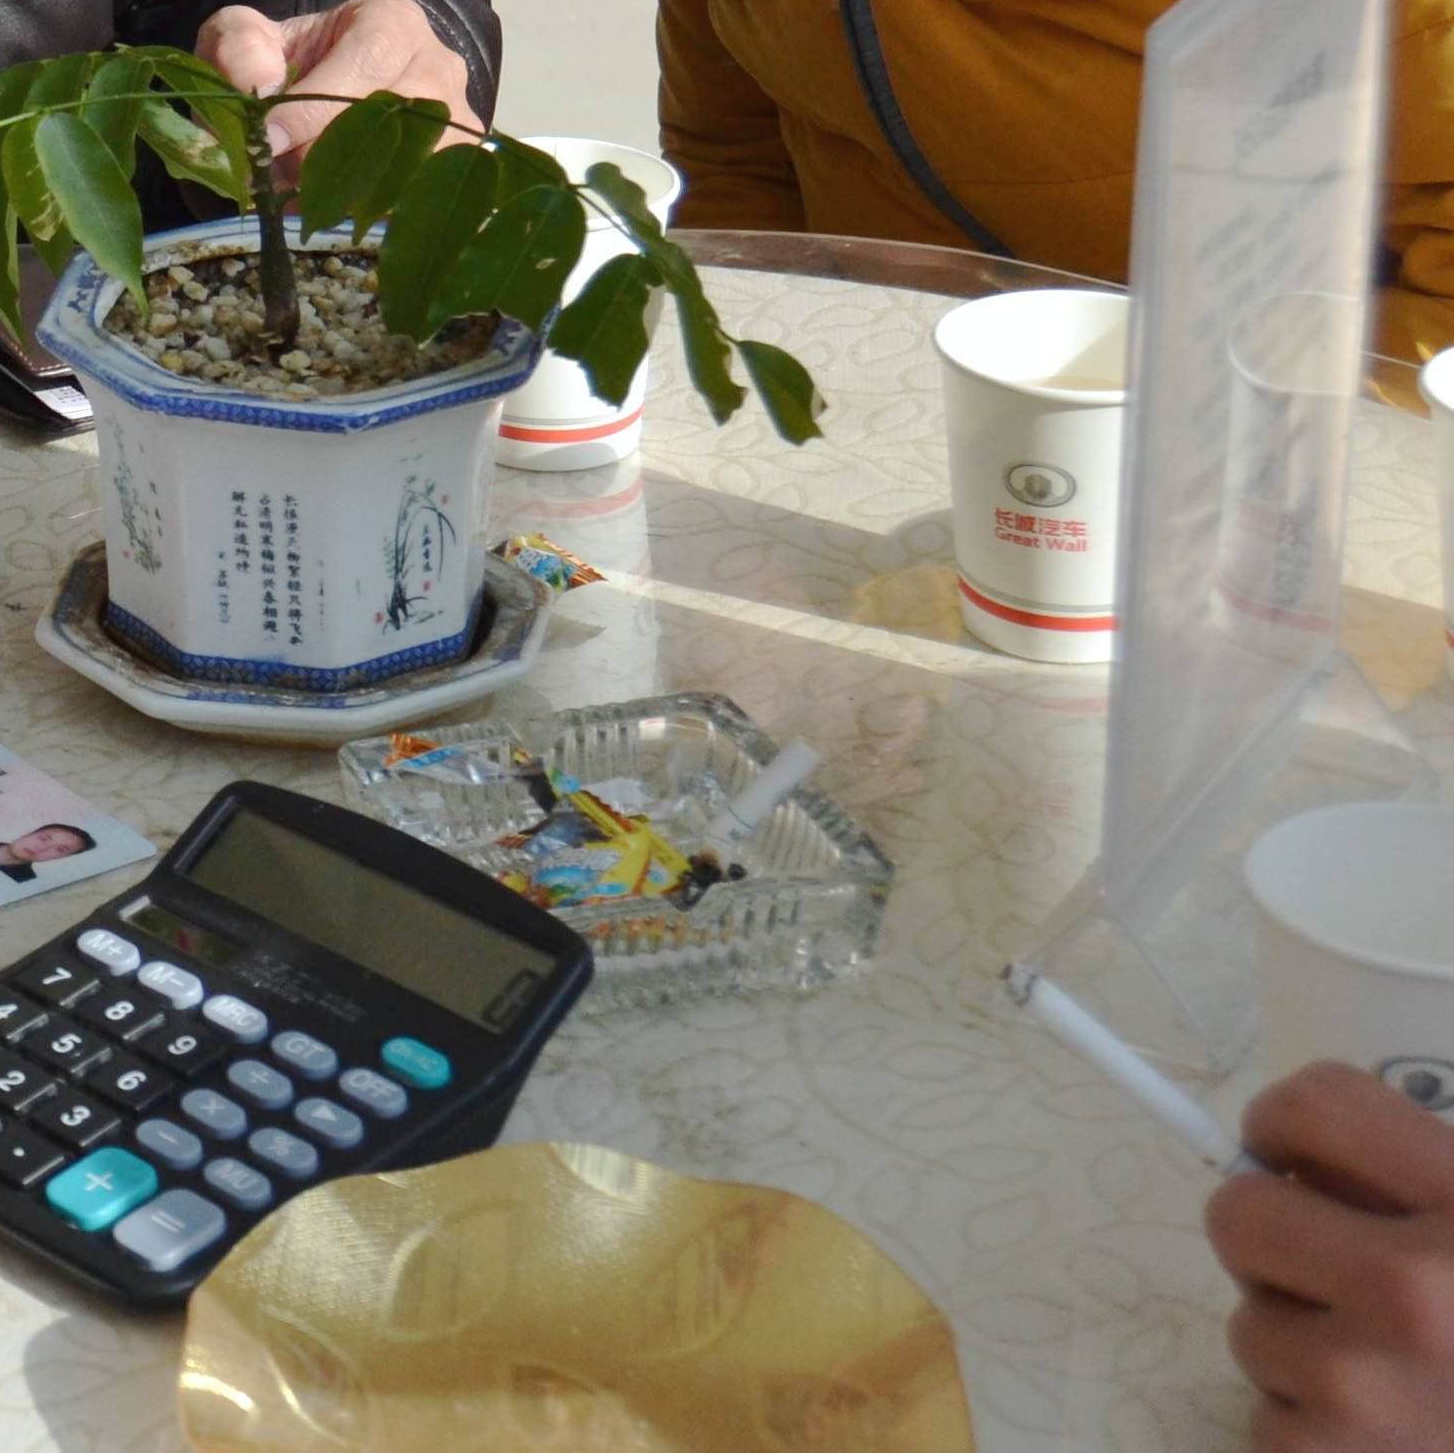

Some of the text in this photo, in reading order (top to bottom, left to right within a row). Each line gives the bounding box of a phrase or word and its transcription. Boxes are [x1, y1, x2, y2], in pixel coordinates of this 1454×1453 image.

[995, 508, 1087, 537] 长城汽车
[996, 526, 1088, 552] Great Wall
[87, 933, 123, 956] M+
[42, 967, 72, 985] 7
[105, 1000, 135, 1021] 8
[212, 999, 260, 1026] MRC
[51, 1033, 83, 1054] 5
[167, 1035, 197, 1055] 9
[287, 1037, 326, 1059] GT
[116, 1070, 147, 1091] 6
[349, 1071, 397, 1097] OFF
[60, 1105, 91, 1126] 3
